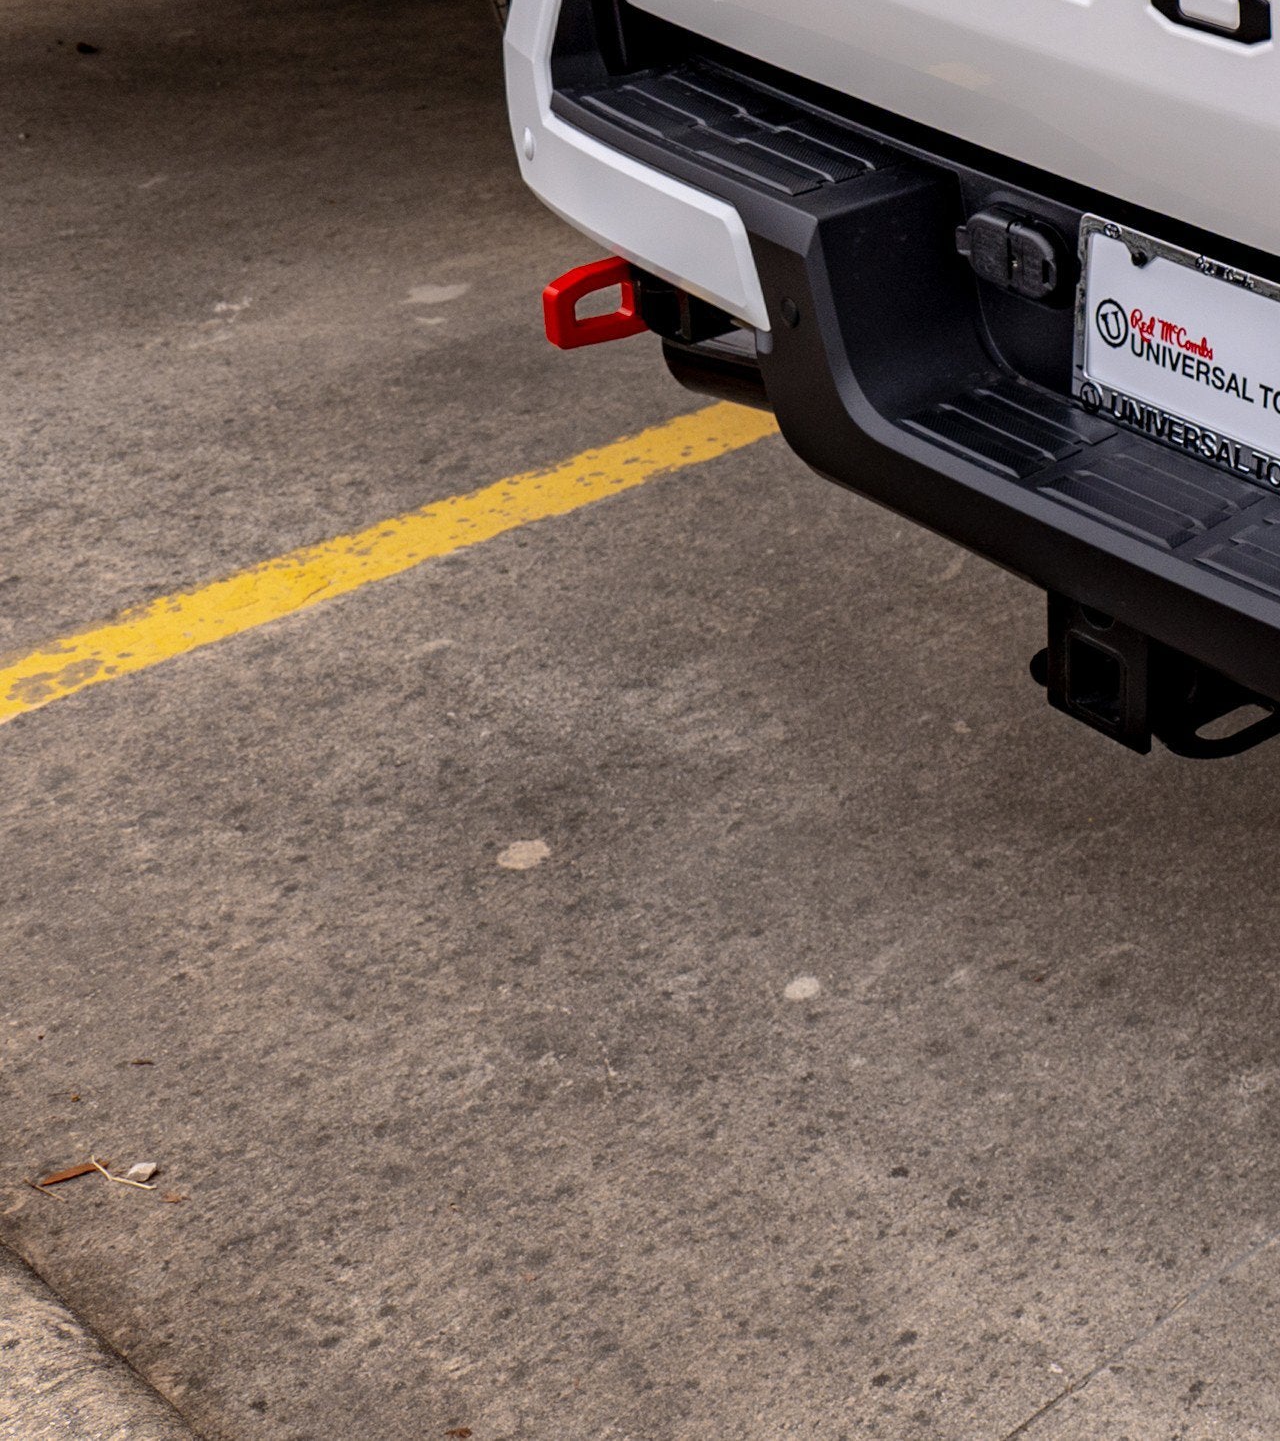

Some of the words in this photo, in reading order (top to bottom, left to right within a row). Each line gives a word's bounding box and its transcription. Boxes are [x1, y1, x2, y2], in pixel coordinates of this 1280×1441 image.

[1130, 308, 1156, 344] Red
[1157, 317, 1214, 361] McCombs
[1131, 332, 1255, 404] UNIVERSAL
[1110, 391, 1250, 474] UNIVERSAL
